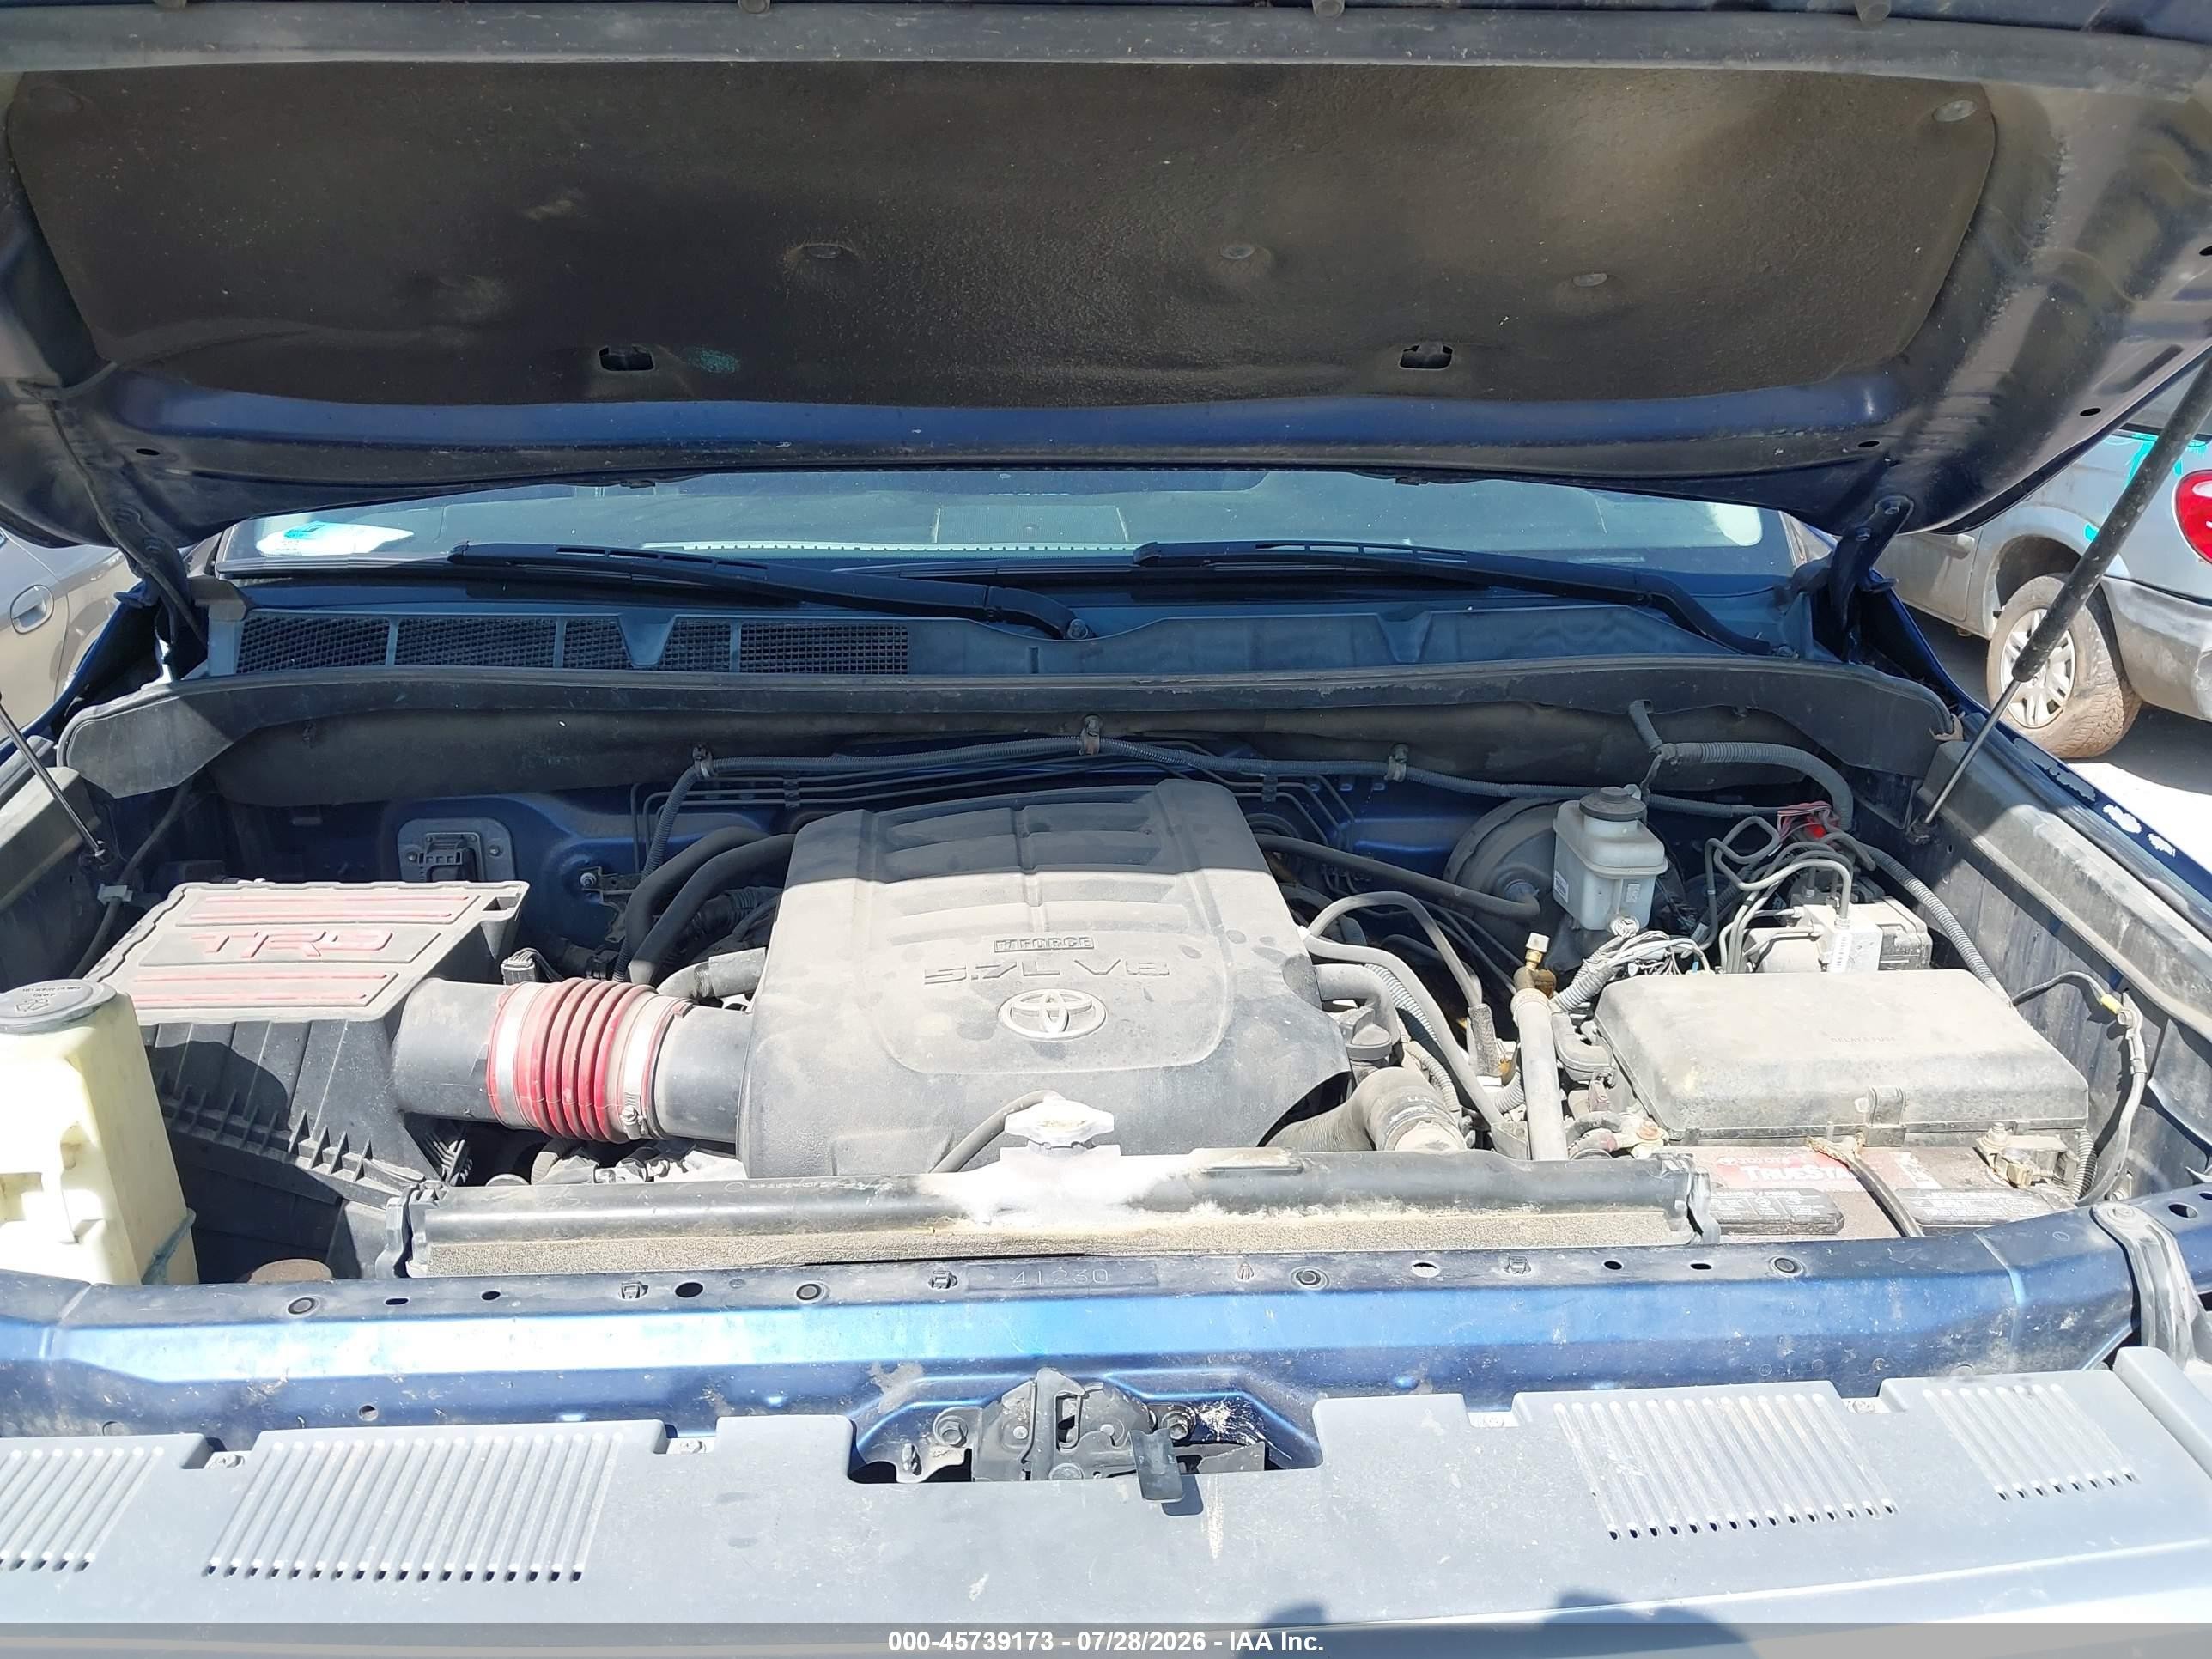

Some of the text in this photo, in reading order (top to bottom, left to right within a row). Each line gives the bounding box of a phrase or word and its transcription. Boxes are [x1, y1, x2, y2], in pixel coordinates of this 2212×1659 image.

[191, 930, 394, 959] TRD
[924, 957, 1170, 985] 5.7L V8
[1012, 1269, 1109, 1285] 41230
